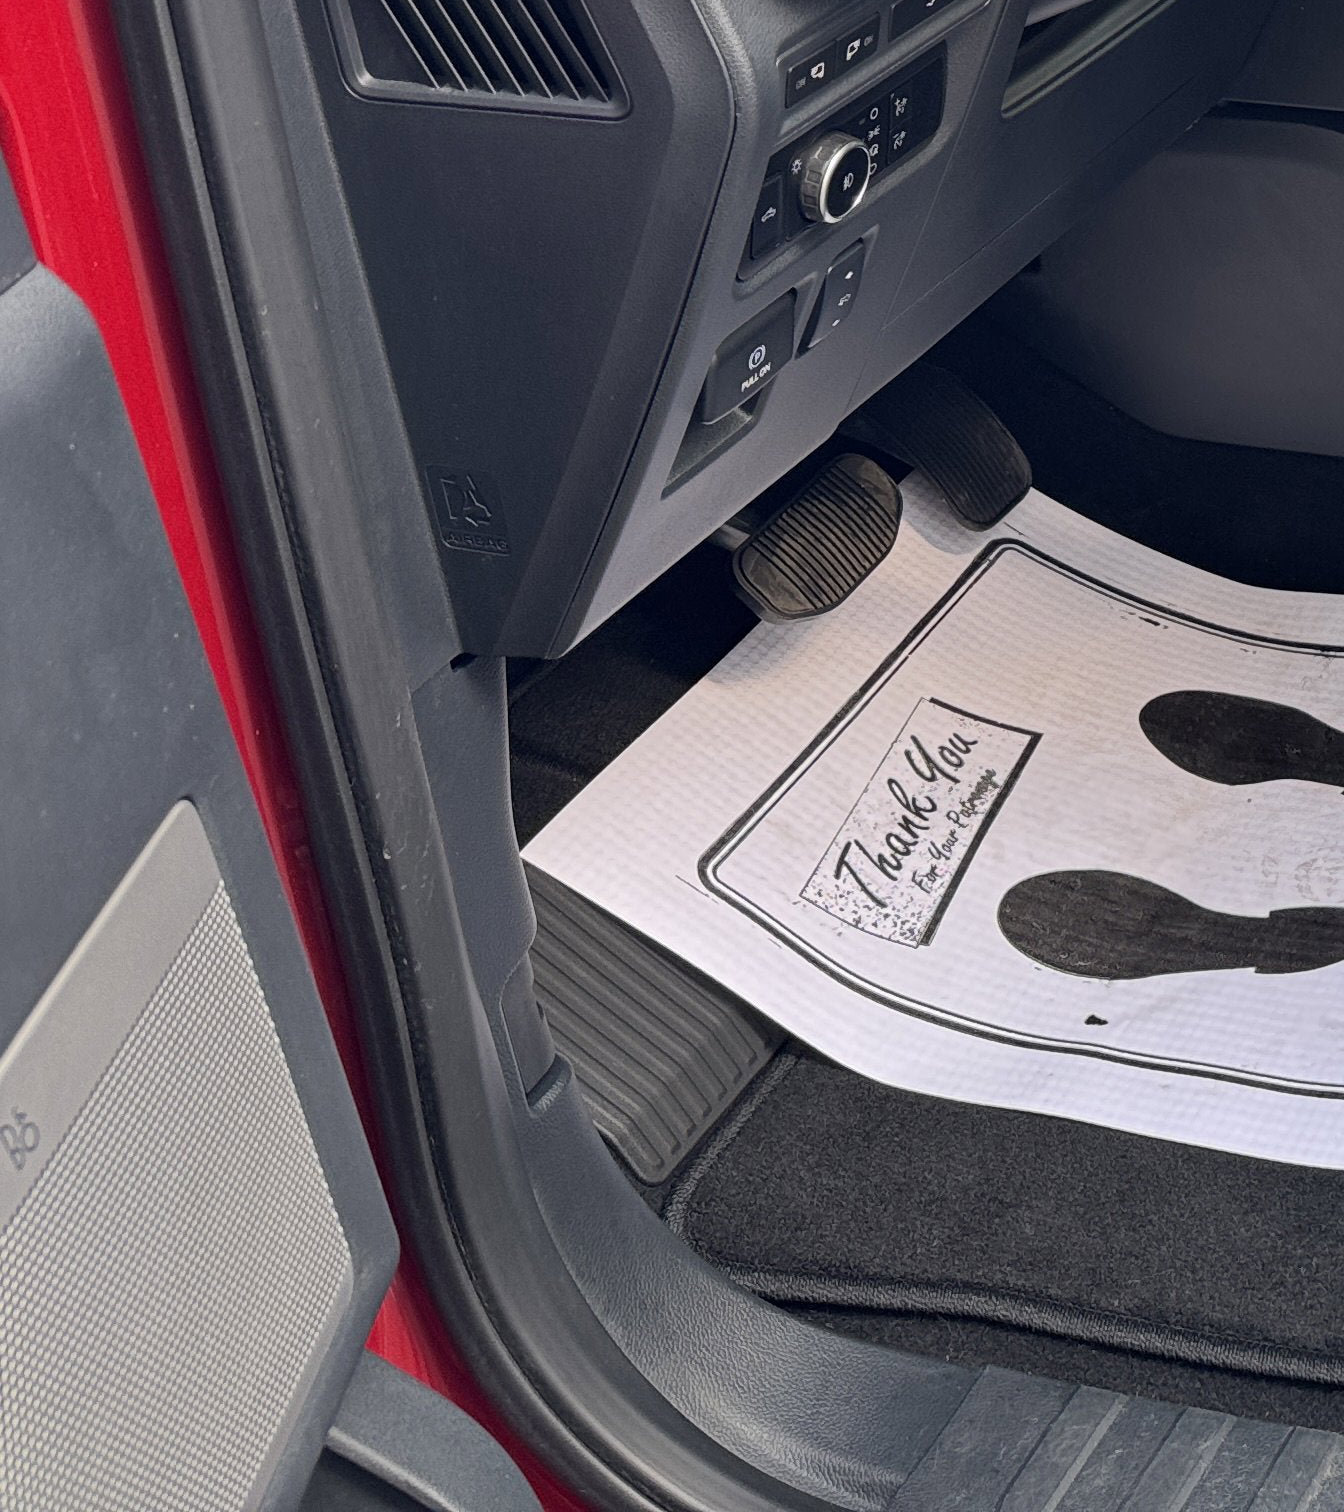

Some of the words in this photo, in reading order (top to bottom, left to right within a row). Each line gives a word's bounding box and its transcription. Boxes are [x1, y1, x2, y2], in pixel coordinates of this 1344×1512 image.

[740, 372, 760, 393] PULL
[759, 361, 772, 378] ON
[447, 532, 509, 551] AIRBAG
[834, 777, 938, 909] Thank
[904, 732, 979, 784] You
[912, 865, 939, 894] For
[927, 827, 959, 862] Your
